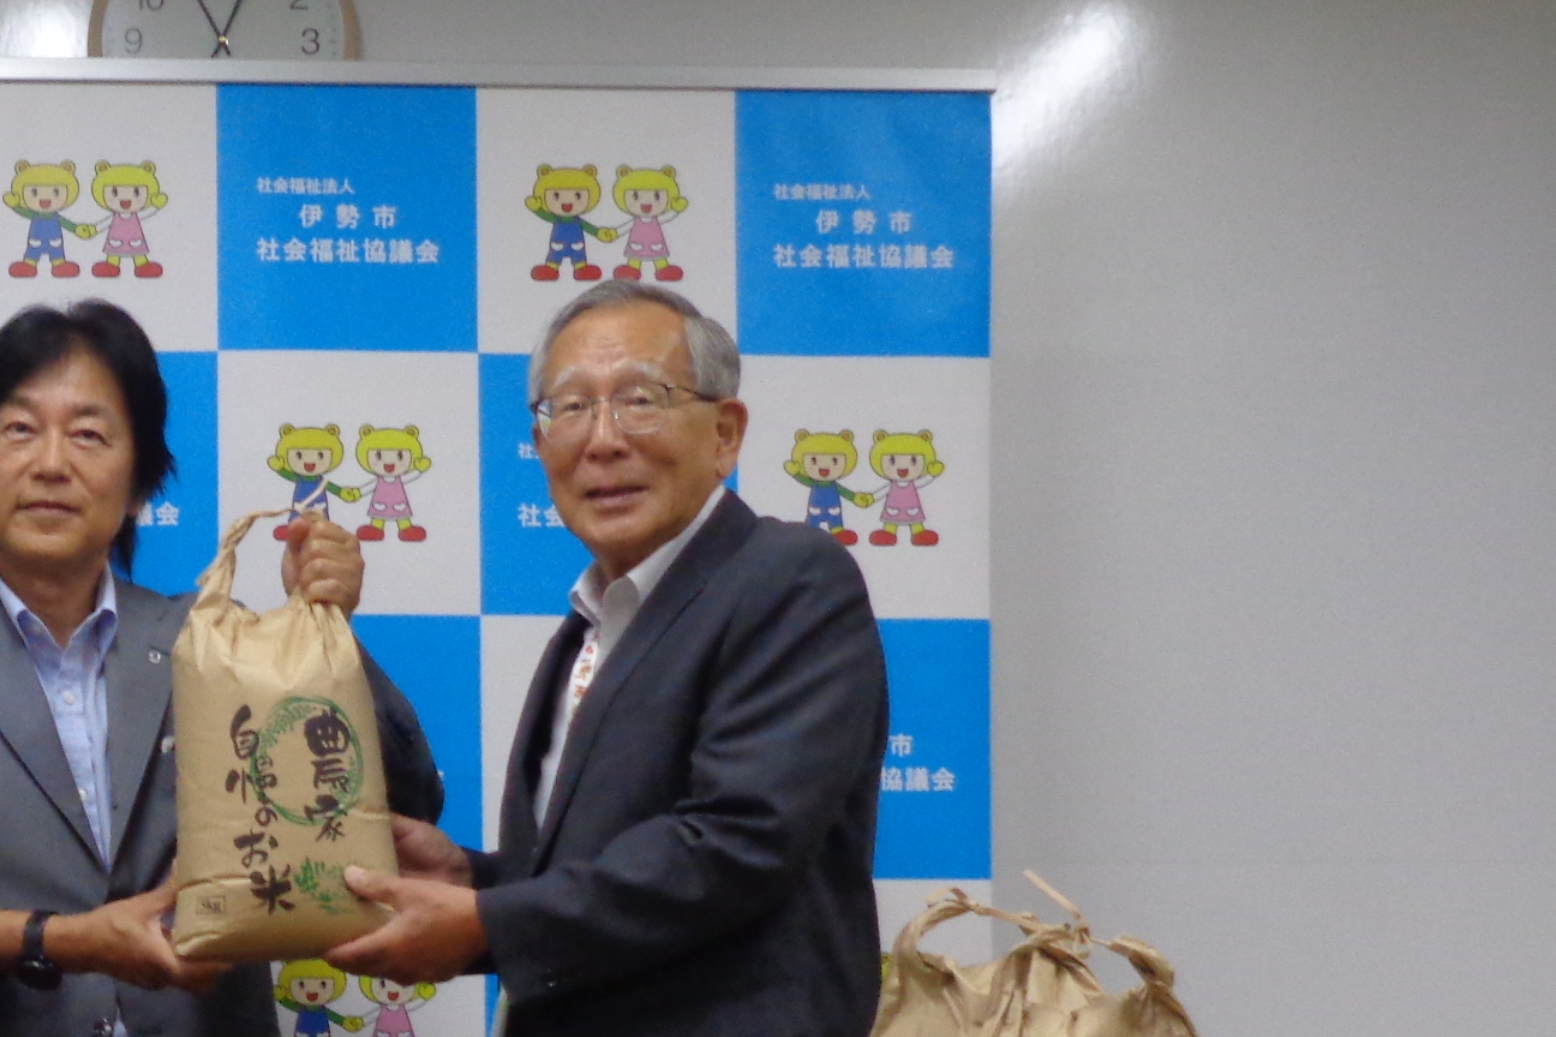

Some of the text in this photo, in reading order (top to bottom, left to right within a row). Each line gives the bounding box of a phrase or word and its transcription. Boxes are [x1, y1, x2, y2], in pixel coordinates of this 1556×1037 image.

[124, 28, 143, 54] 9
[301, 28, 320, 54] 3
[257, 177, 355, 195] 社会福祉法人
[774, 184, 871, 200] 社会福祉法人
[299, 204, 398, 229] 伊勢市
[815, 210, 914, 235] 伊勢市
[257, 238, 440, 264] 社会福祉協議会
[774, 244, 955, 270] 社会福祉協議会
